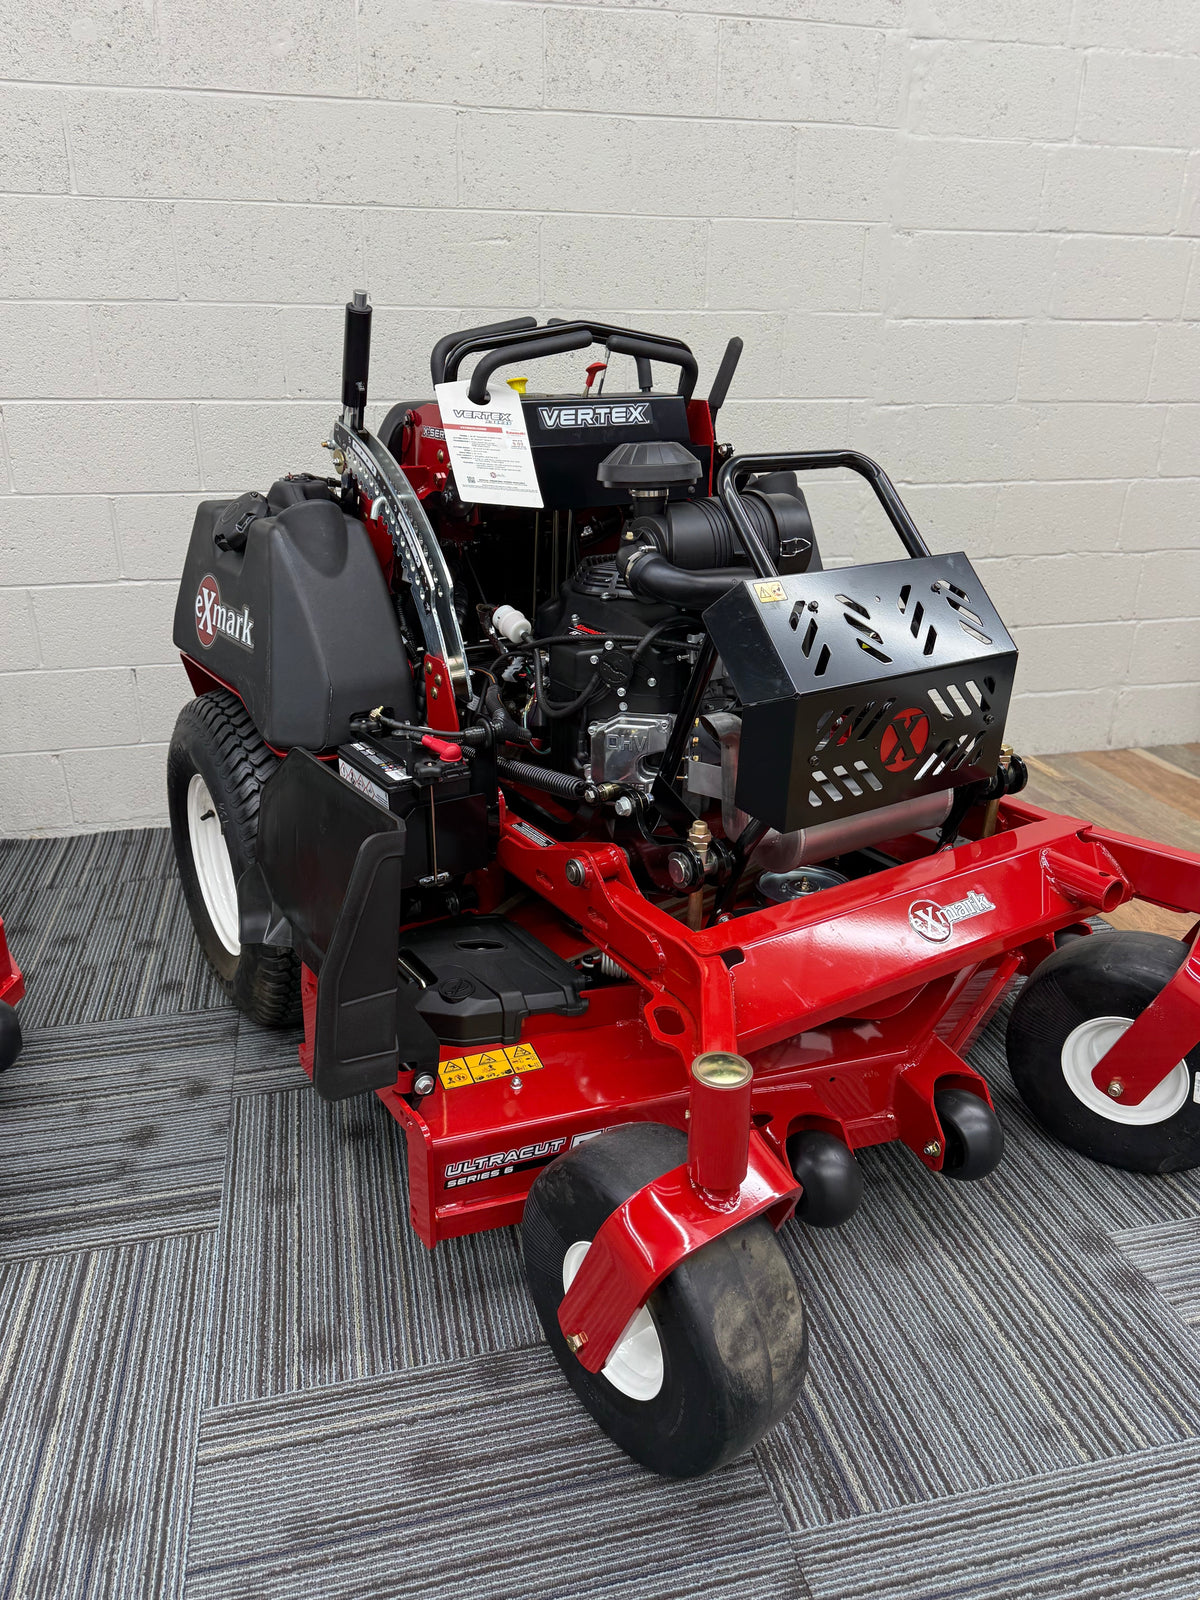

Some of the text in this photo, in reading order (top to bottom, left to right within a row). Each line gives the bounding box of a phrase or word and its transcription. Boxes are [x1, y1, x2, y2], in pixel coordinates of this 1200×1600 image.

[454, 409, 511, 422] VERTEX
[538, 403, 650, 429] VERTEX
[421, 425, 446, 441] X-SER
[884, 713, 928, 766] X
[445, 1137, 567, 1178] ULTRACUT
[446, 1165, 514, 1188] SERIES 6
